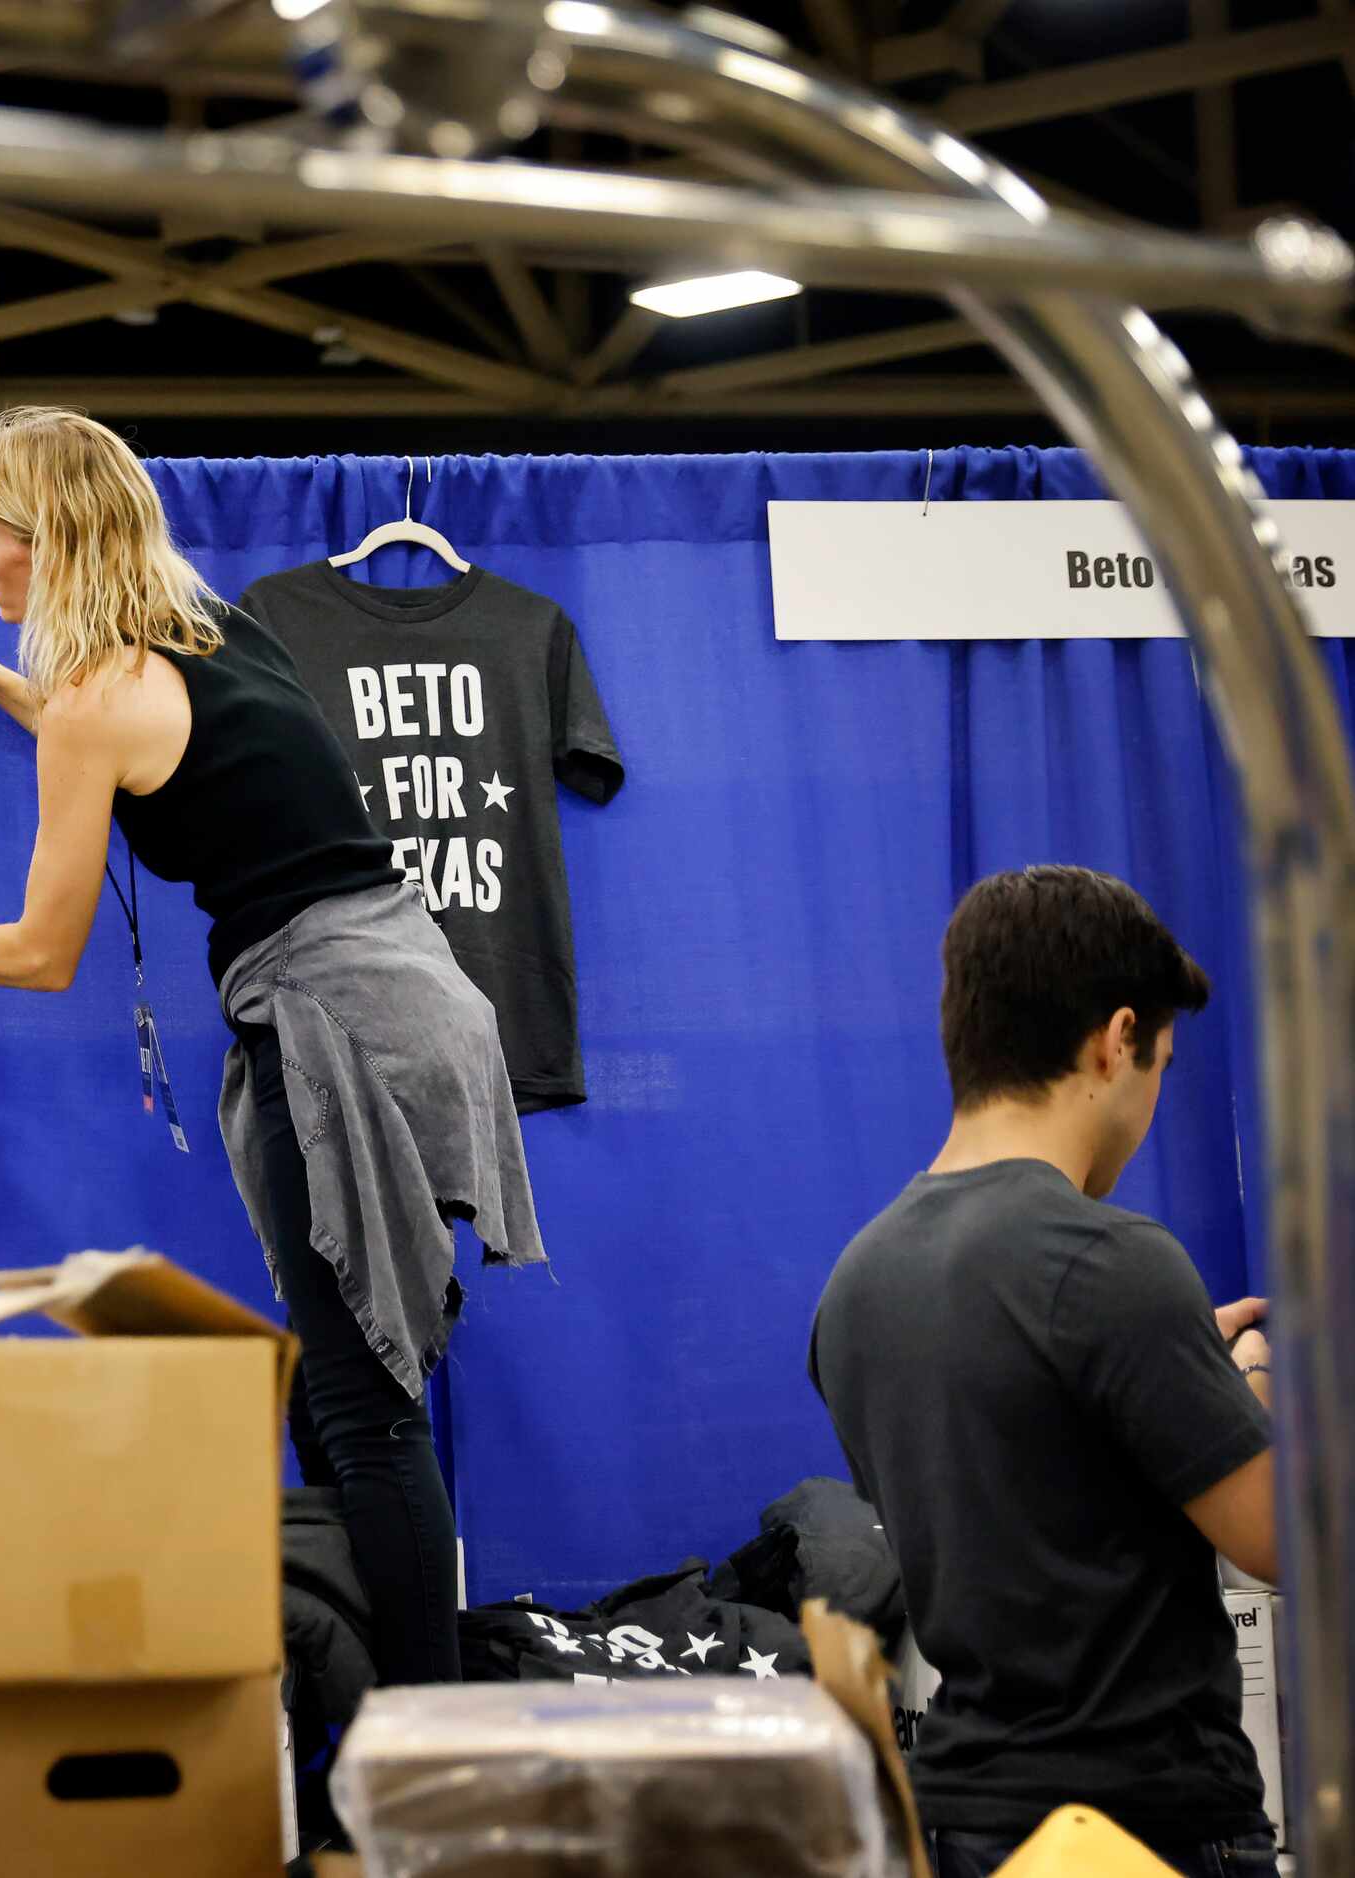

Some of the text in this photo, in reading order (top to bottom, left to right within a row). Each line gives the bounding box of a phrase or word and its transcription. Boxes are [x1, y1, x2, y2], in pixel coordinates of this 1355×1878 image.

[1067, 551, 1154, 588] Beto
[347, 663, 485, 739] BETO
[382, 754, 467, 820] FOR
[391, 836, 503, 912] EXAS
